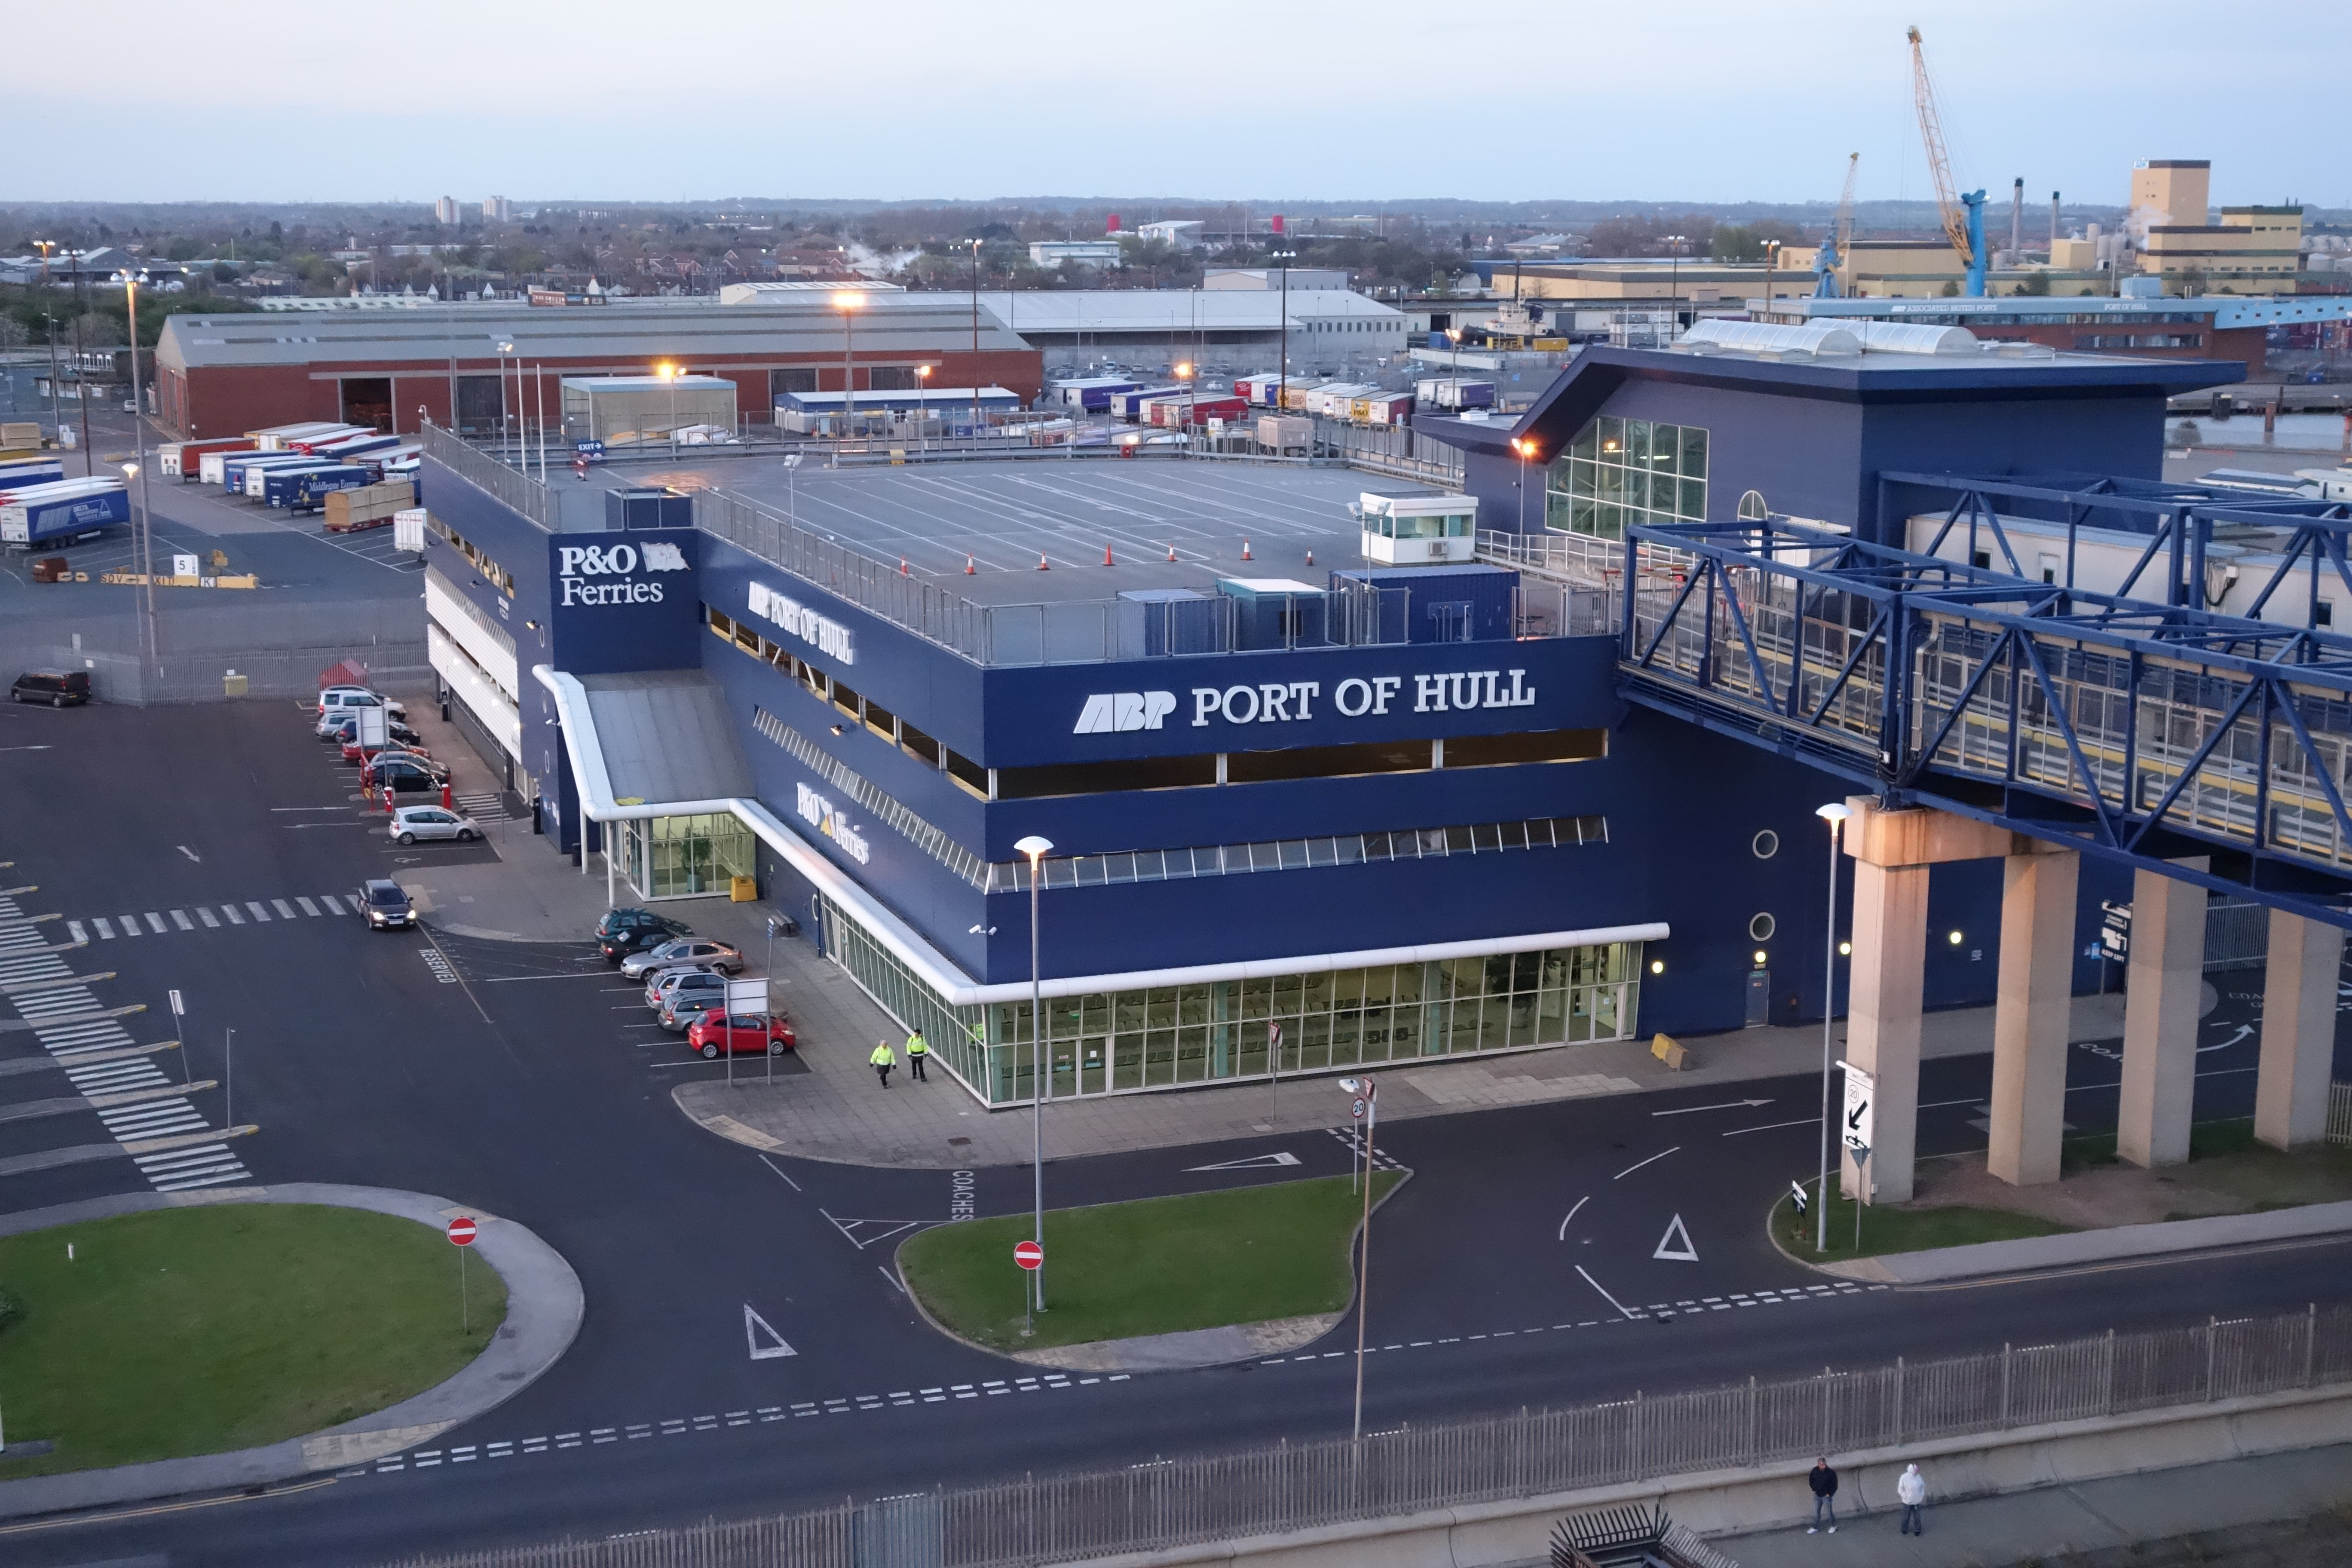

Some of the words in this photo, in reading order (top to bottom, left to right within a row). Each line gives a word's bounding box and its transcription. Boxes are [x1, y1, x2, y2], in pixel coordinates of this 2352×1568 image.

[179, 560, 185, 570] 5
[559, 544, 637, 575] P&O
[101, 574, 122, 584] SDV
[560, 577, 664, 606] Ferries
[771, 591, 801, 635] PORT
[800, 608, 818, 645] OF
[818, 616, 853, 665] HULL
[1074, 691, 1176, 734] ABP
[1192, 682, 1319, 726] PORT
[1335, 676, 1400, 716] OF
[1414, 669, 1535, 713] HULL
[797, 782, 820, 826] P&O
[835, 812, 869, 864] Ferries
[418, 949, 457, 983] RESERVED
[2102, 948, 2113, 958] KEEP
[2114, 953, 2124, 962] LEFT
[1354, 1103, 1363, 1113] 20
[1850, 1089, 1857, 1099] 20
[952, 1170, 974, 1220] COACHES
